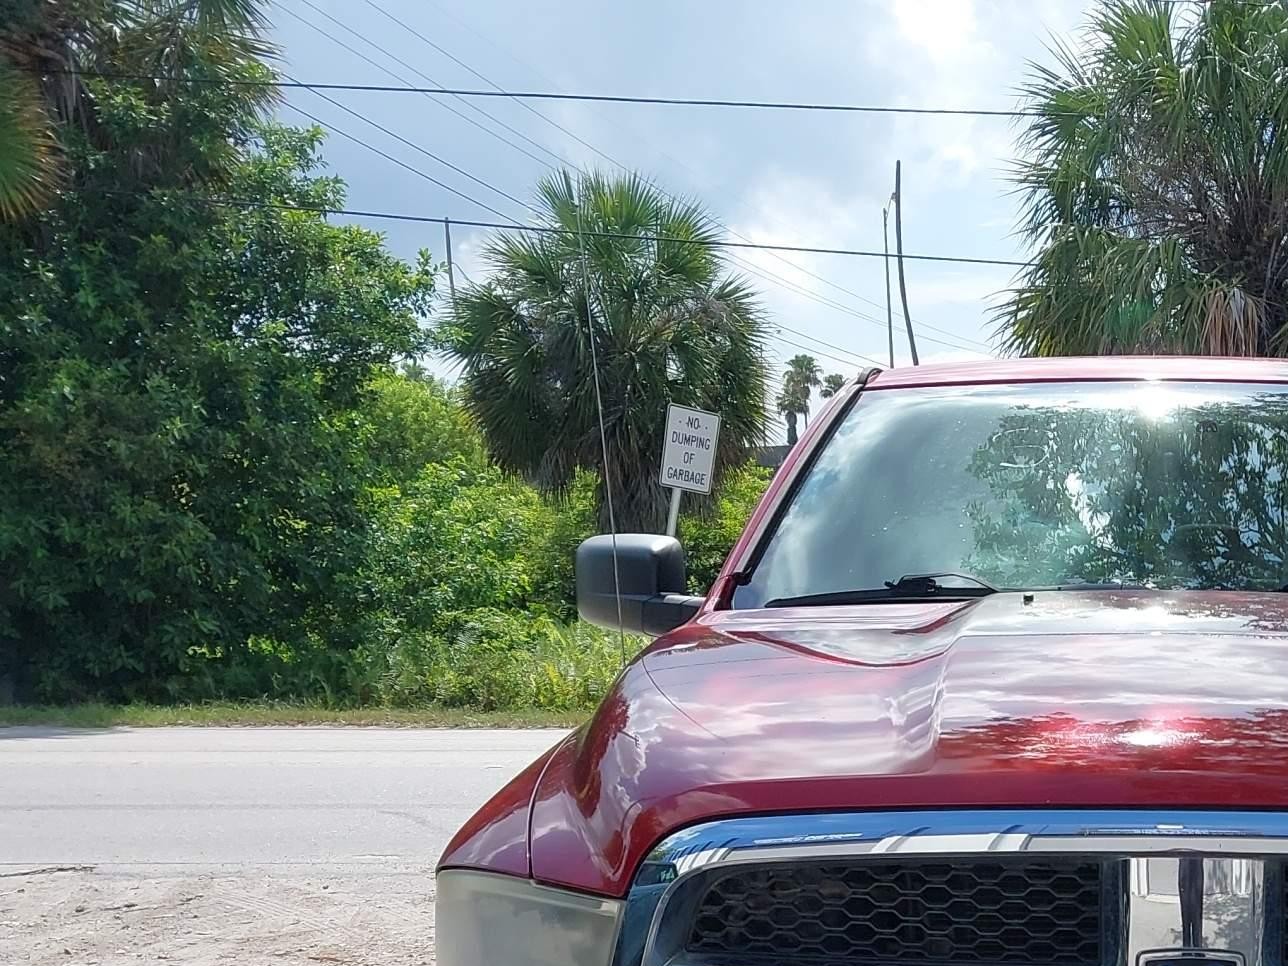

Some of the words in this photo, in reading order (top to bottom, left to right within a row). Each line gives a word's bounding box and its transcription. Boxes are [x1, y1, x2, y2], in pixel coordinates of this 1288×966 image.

[687, 416, 700, 430] NO
[671, 431, 711, 450] DUMPING
[683, 452, 695, 464] OF
[667, 466, 706, 485] GARBAGE
